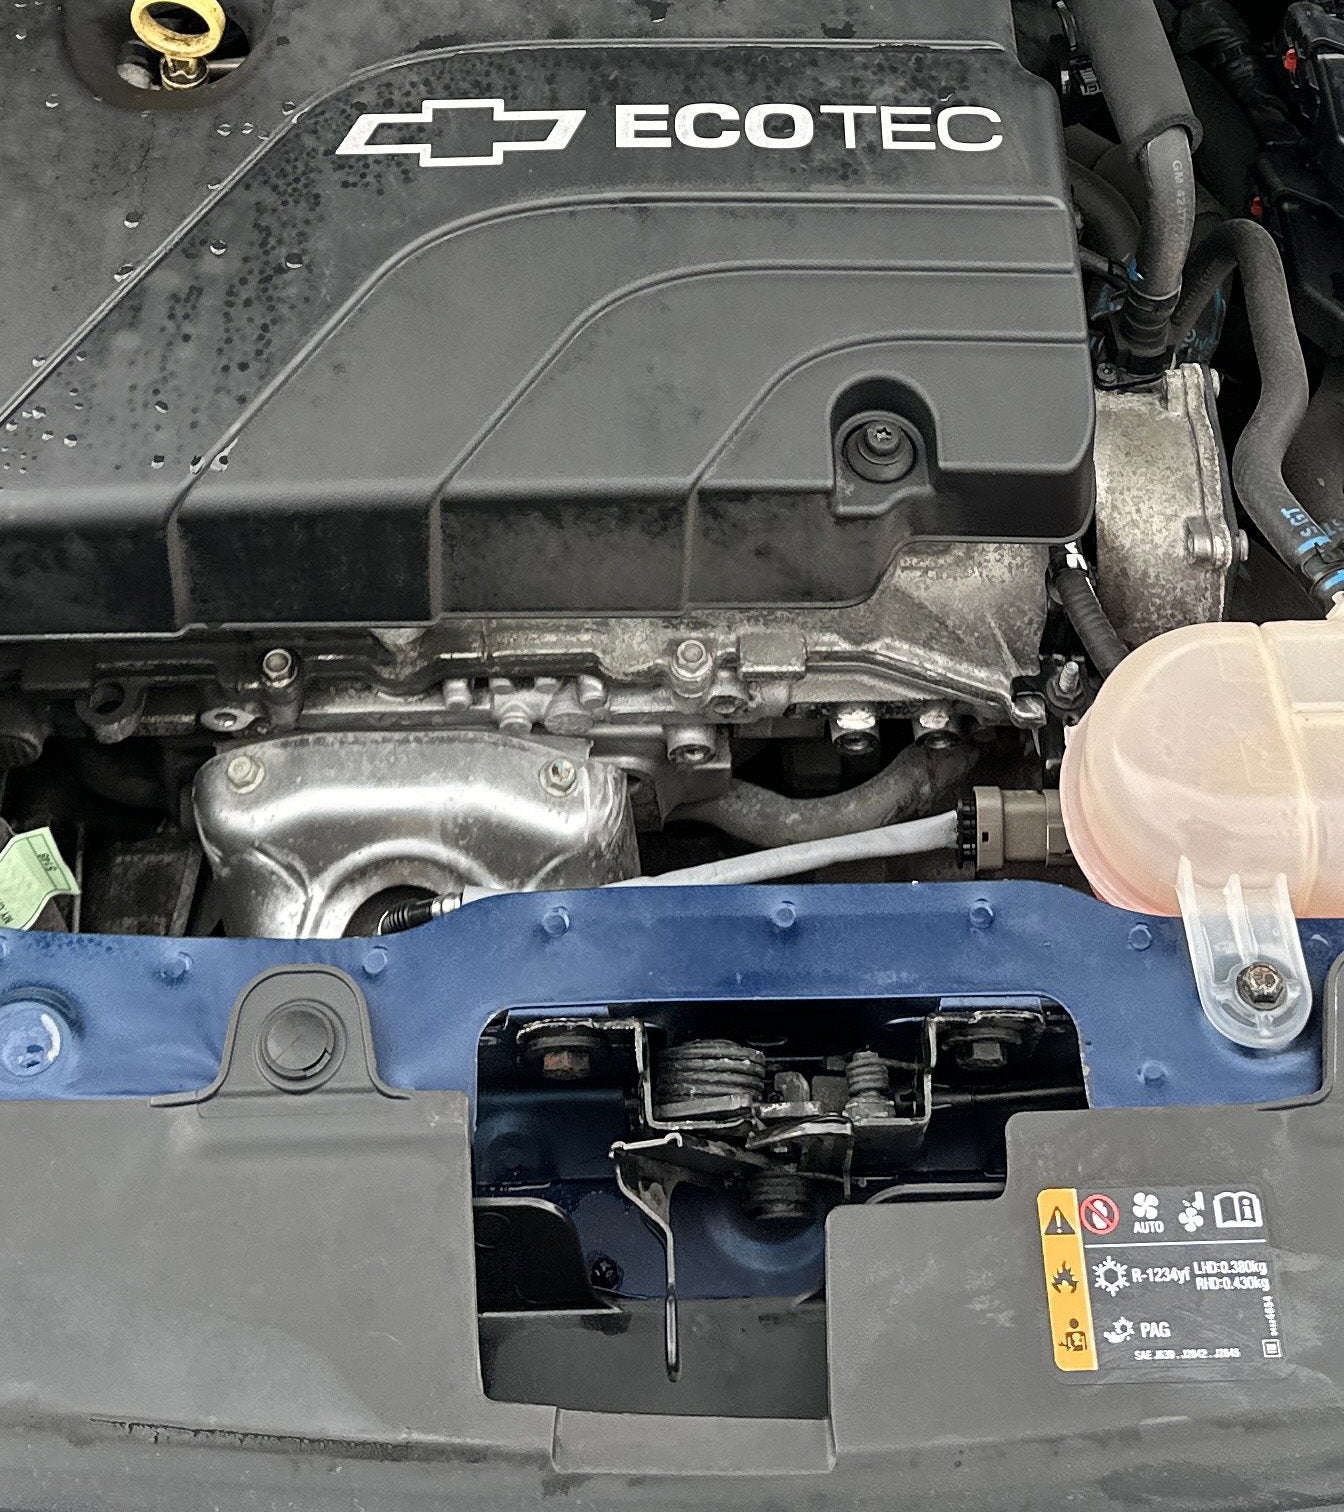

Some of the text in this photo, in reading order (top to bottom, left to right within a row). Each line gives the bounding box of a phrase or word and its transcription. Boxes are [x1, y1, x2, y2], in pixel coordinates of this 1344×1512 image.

[615, 103, 1003, 152] ECOTEC
[1172, 159, 1184, 184] GM
[1133, 1221, 1164, 1234] AUTO
[1131, 1266, 1191, 1285] R-1234yf
[1193, 1260, 1267, 1276] LHD:0.380kg
[1196, 1276, 1271, 1292] RHD:0.430kg
[1140, 1321, 1171, 1338] PAG
[1134, 1349, 1153, 1360] SAE
